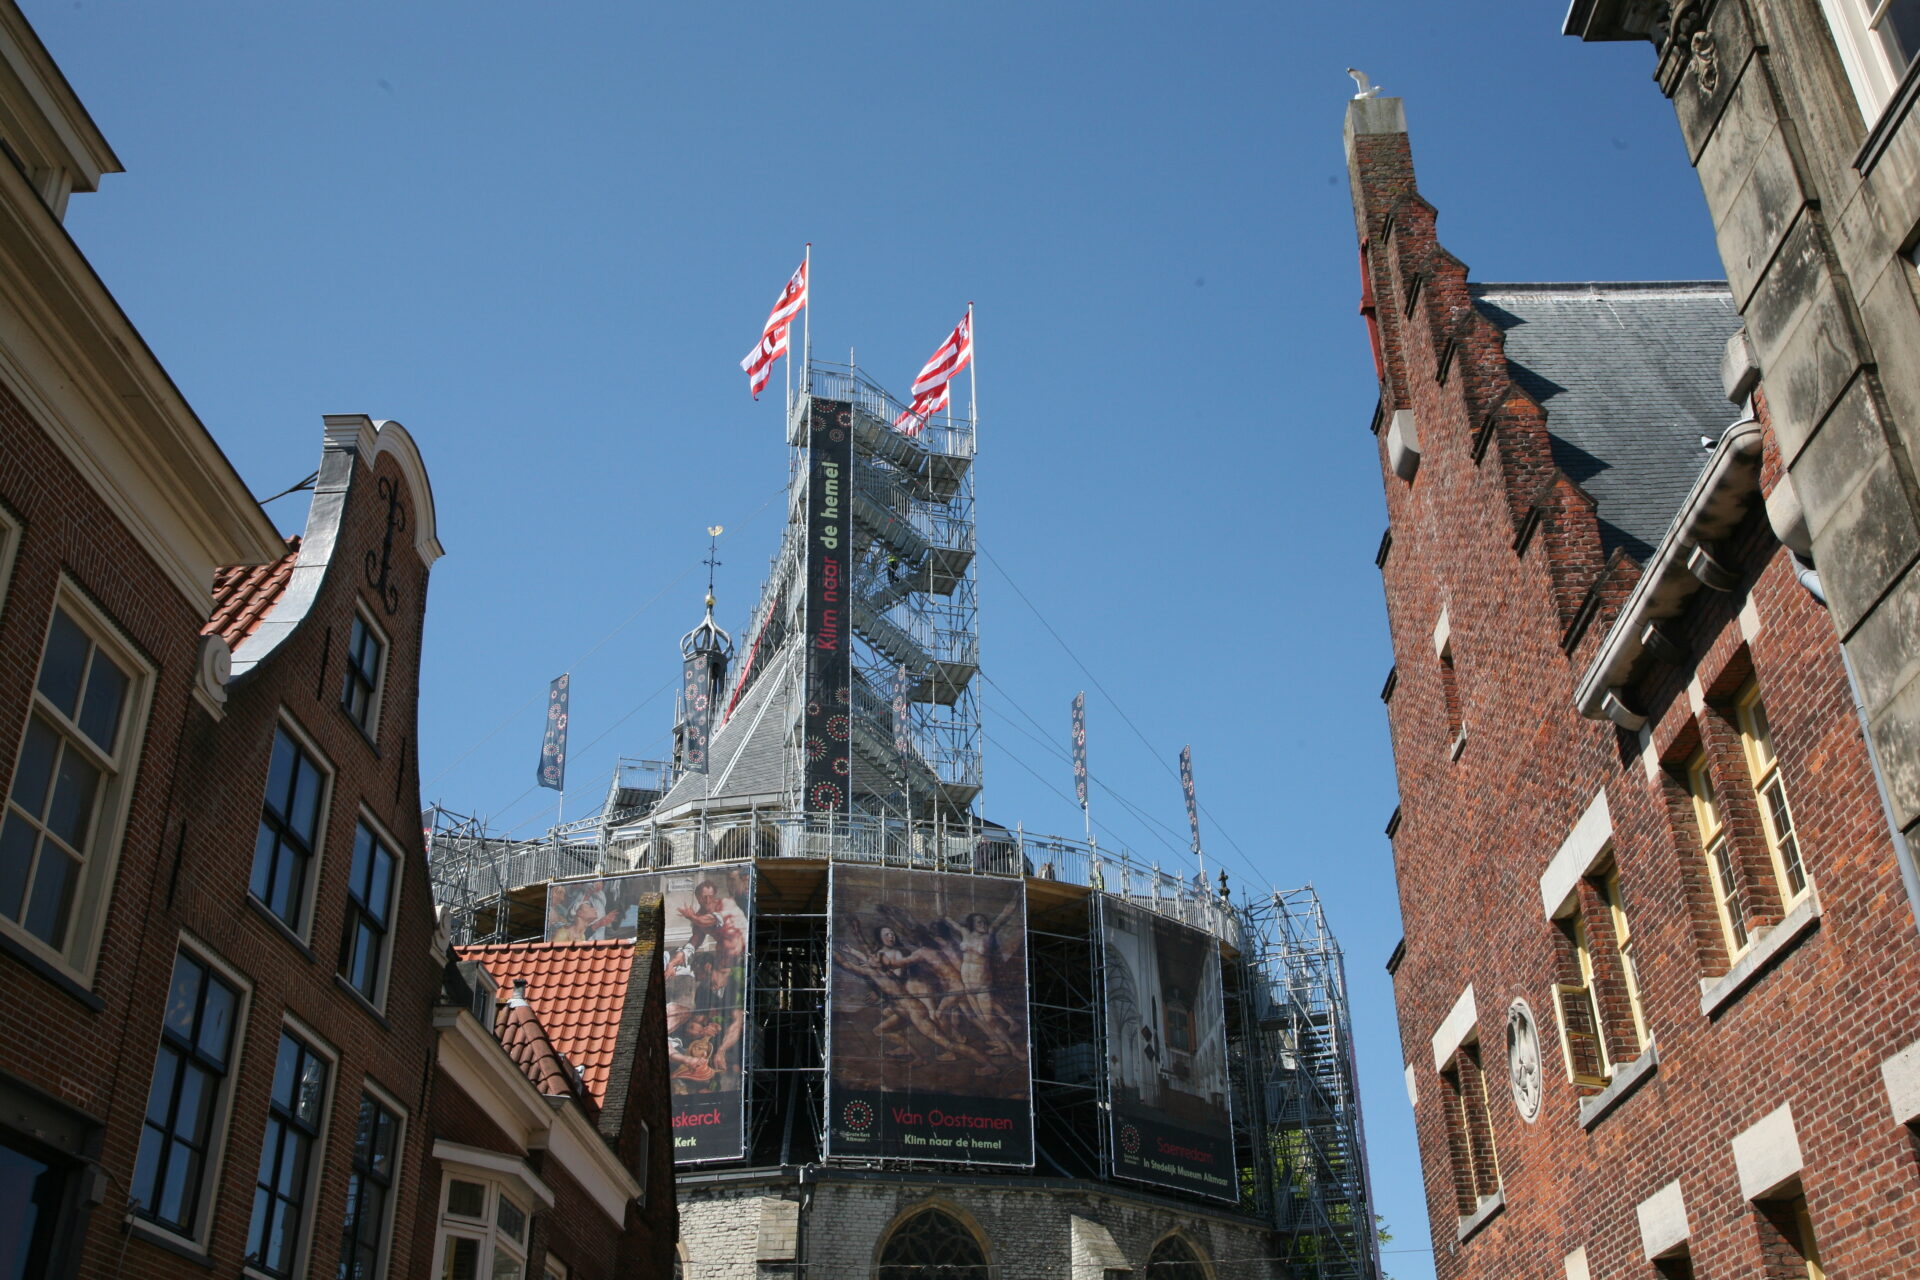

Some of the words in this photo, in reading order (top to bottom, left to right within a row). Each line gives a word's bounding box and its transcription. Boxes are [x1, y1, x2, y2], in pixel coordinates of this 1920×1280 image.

[820, 461, 839, 519] hemel
[820, 522, 838, 550] de
[822, 557, 838, 602] naar
[817, 609, 838, 651] Klim
[891, 1107, 923, 1125] Van
[928, 1109, 1013, 1130] Oostsanen
[674, 1136, 697, 1148] Kerk
[904, 1134, 926, 1146] Klim
[929, 1138, 953, 1148] naar
[955, 1137, 969, 1148] de
[971, 1139, 1002, 1150] hemel
[1143, 1158, 1150, 1168] In
[1150, 1159, 1177, 1176] Stedelijk
[1177, 1165, 1203, 1181] Museum
[1203, 1172, 1229, 1186] Alkmaar
